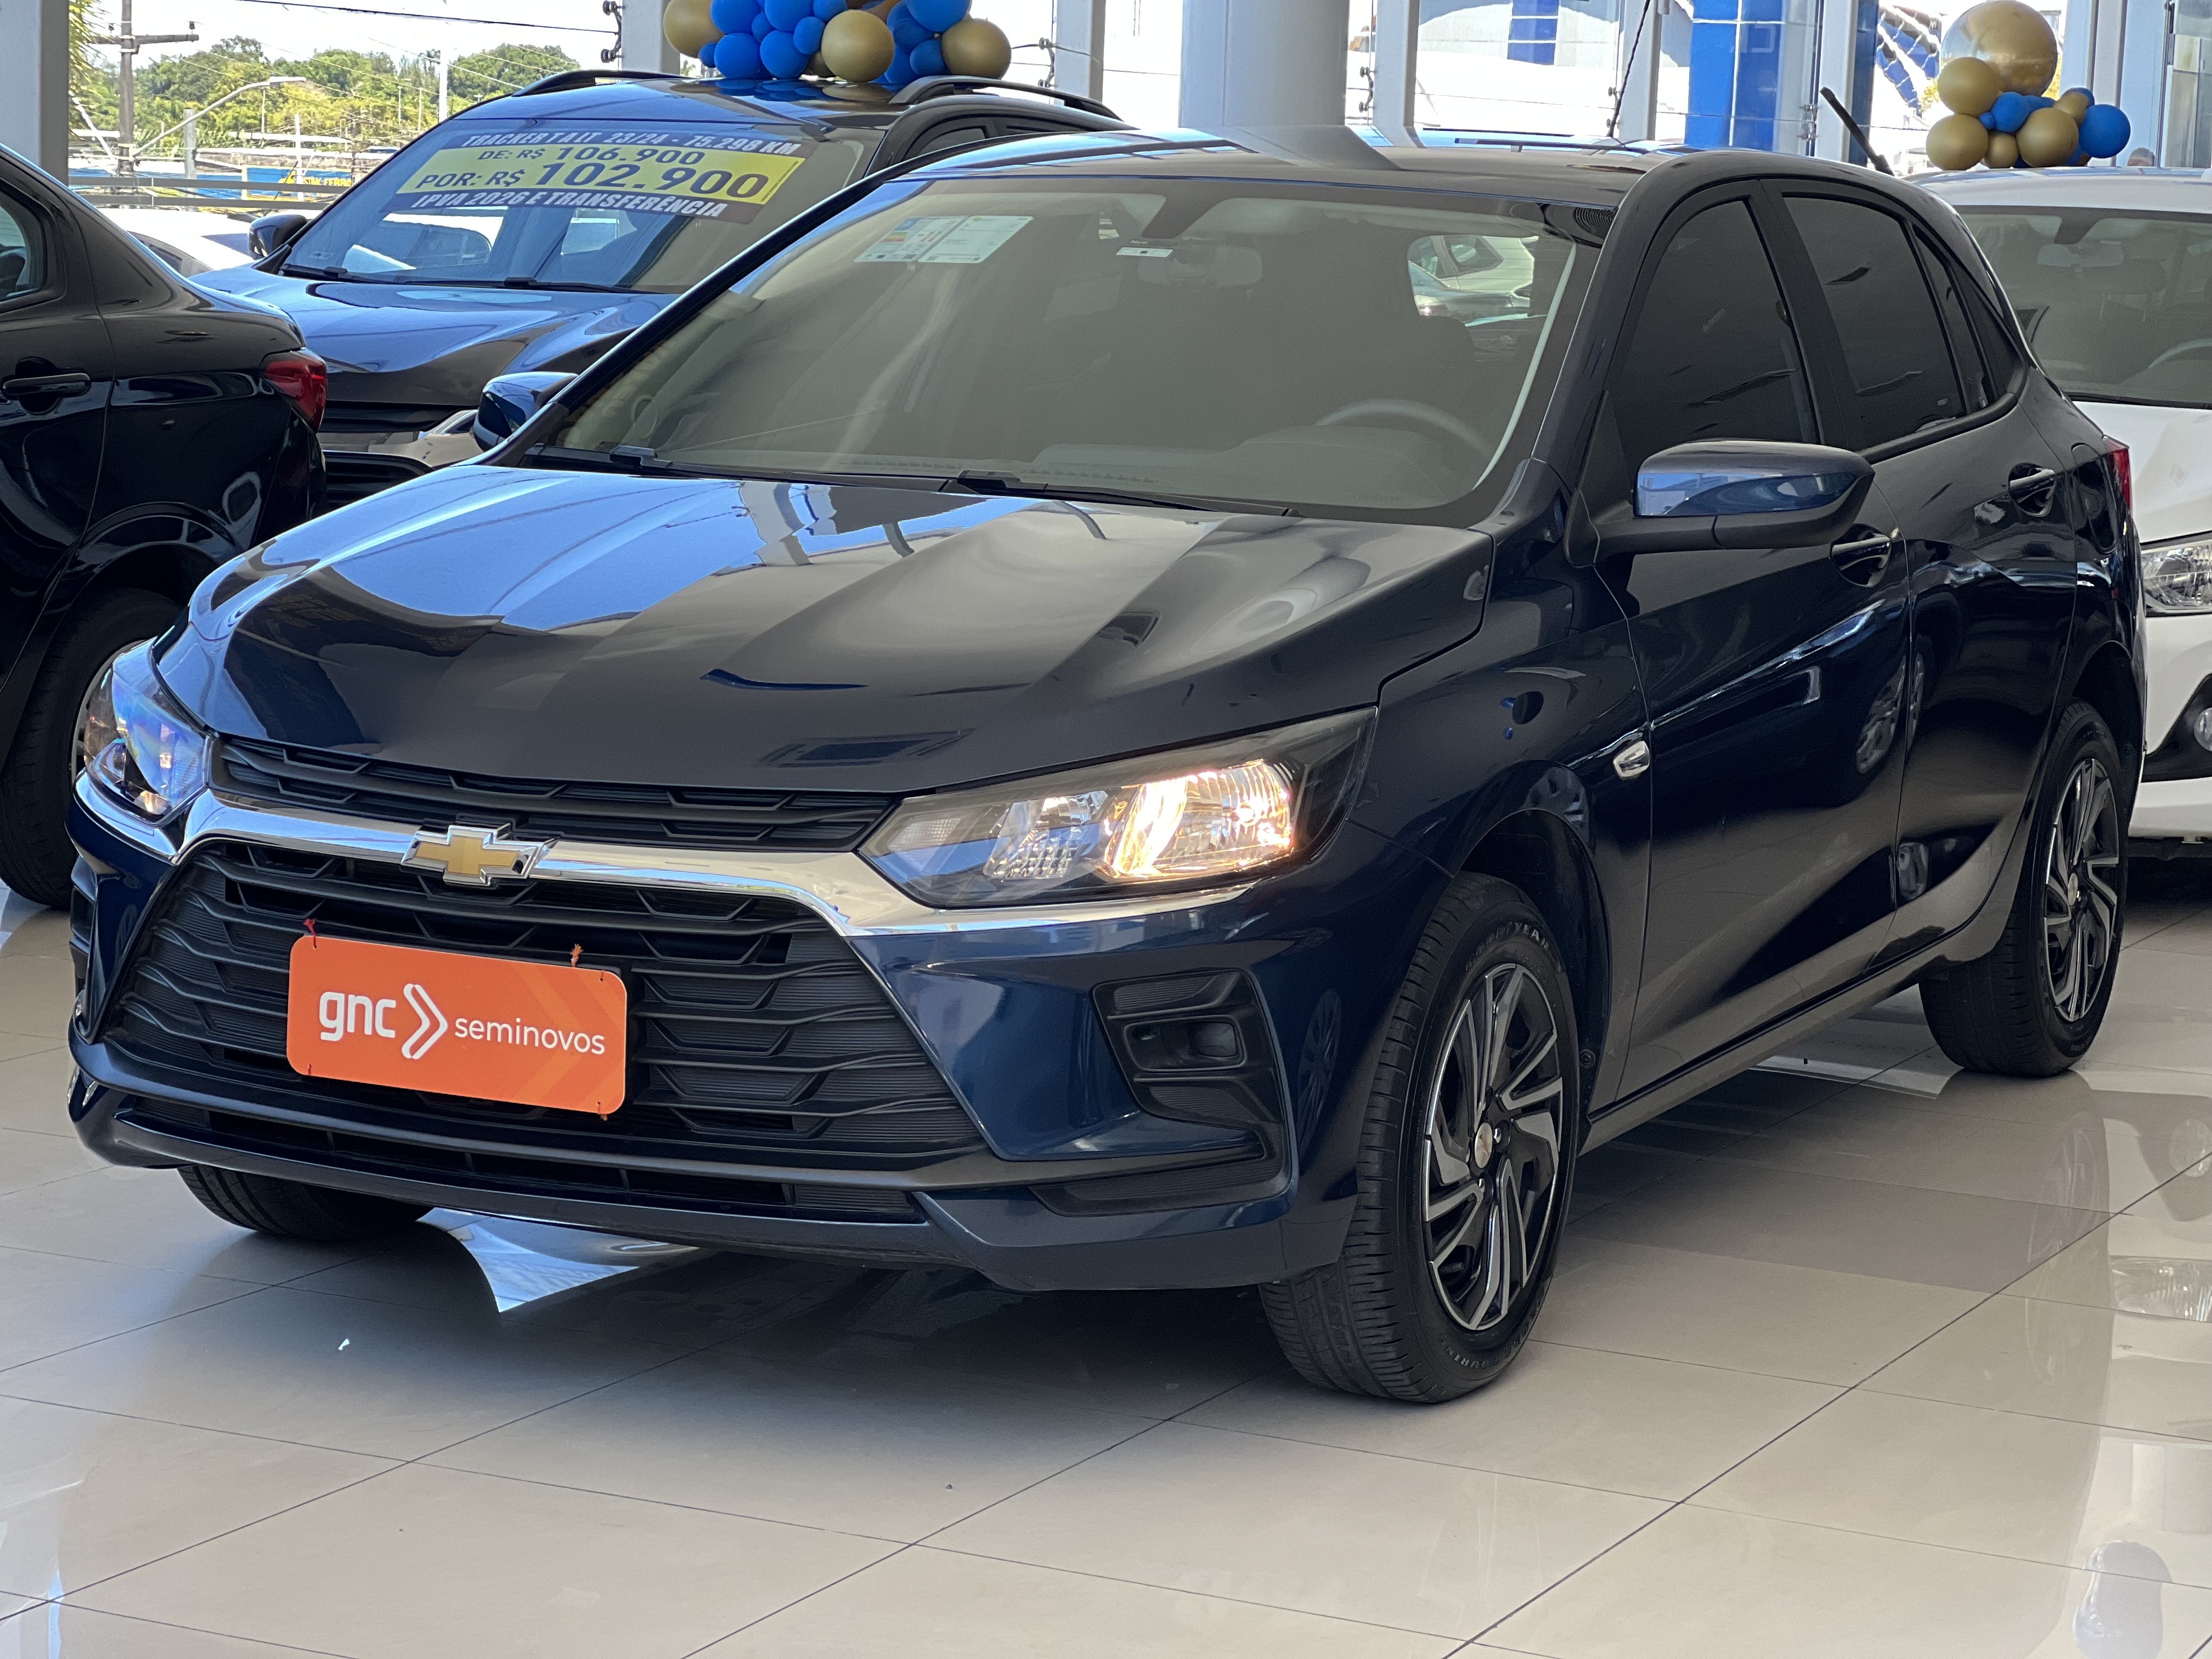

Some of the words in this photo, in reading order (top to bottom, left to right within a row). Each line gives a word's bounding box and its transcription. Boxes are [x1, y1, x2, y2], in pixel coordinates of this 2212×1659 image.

[461, 132, 549, 146] TRACKER
[603, 132, 669, 144] 23/24
[683, 135, 763, 151] 75.298
[759, 142, 801, 155] KM
[477, 150, 513, 160] DE:
[516, 148, 546, 159] R$
[556, 146, 705, 165] 106.900
[414, 172, 483, 189] POR:
[484, 169, 526, 187] R$
[535, 162, 769, 198] 102.900
[411, 193, 469, 208] IPVA
[464, 191, 531, 206] 2026
[524, 192, 548, 205] E
[543, 192, 727, 217] TRANSFERÊNCIA
[319, 991, 396, 1041] gnc
[454, 1017, 605, 1055] seminovos
